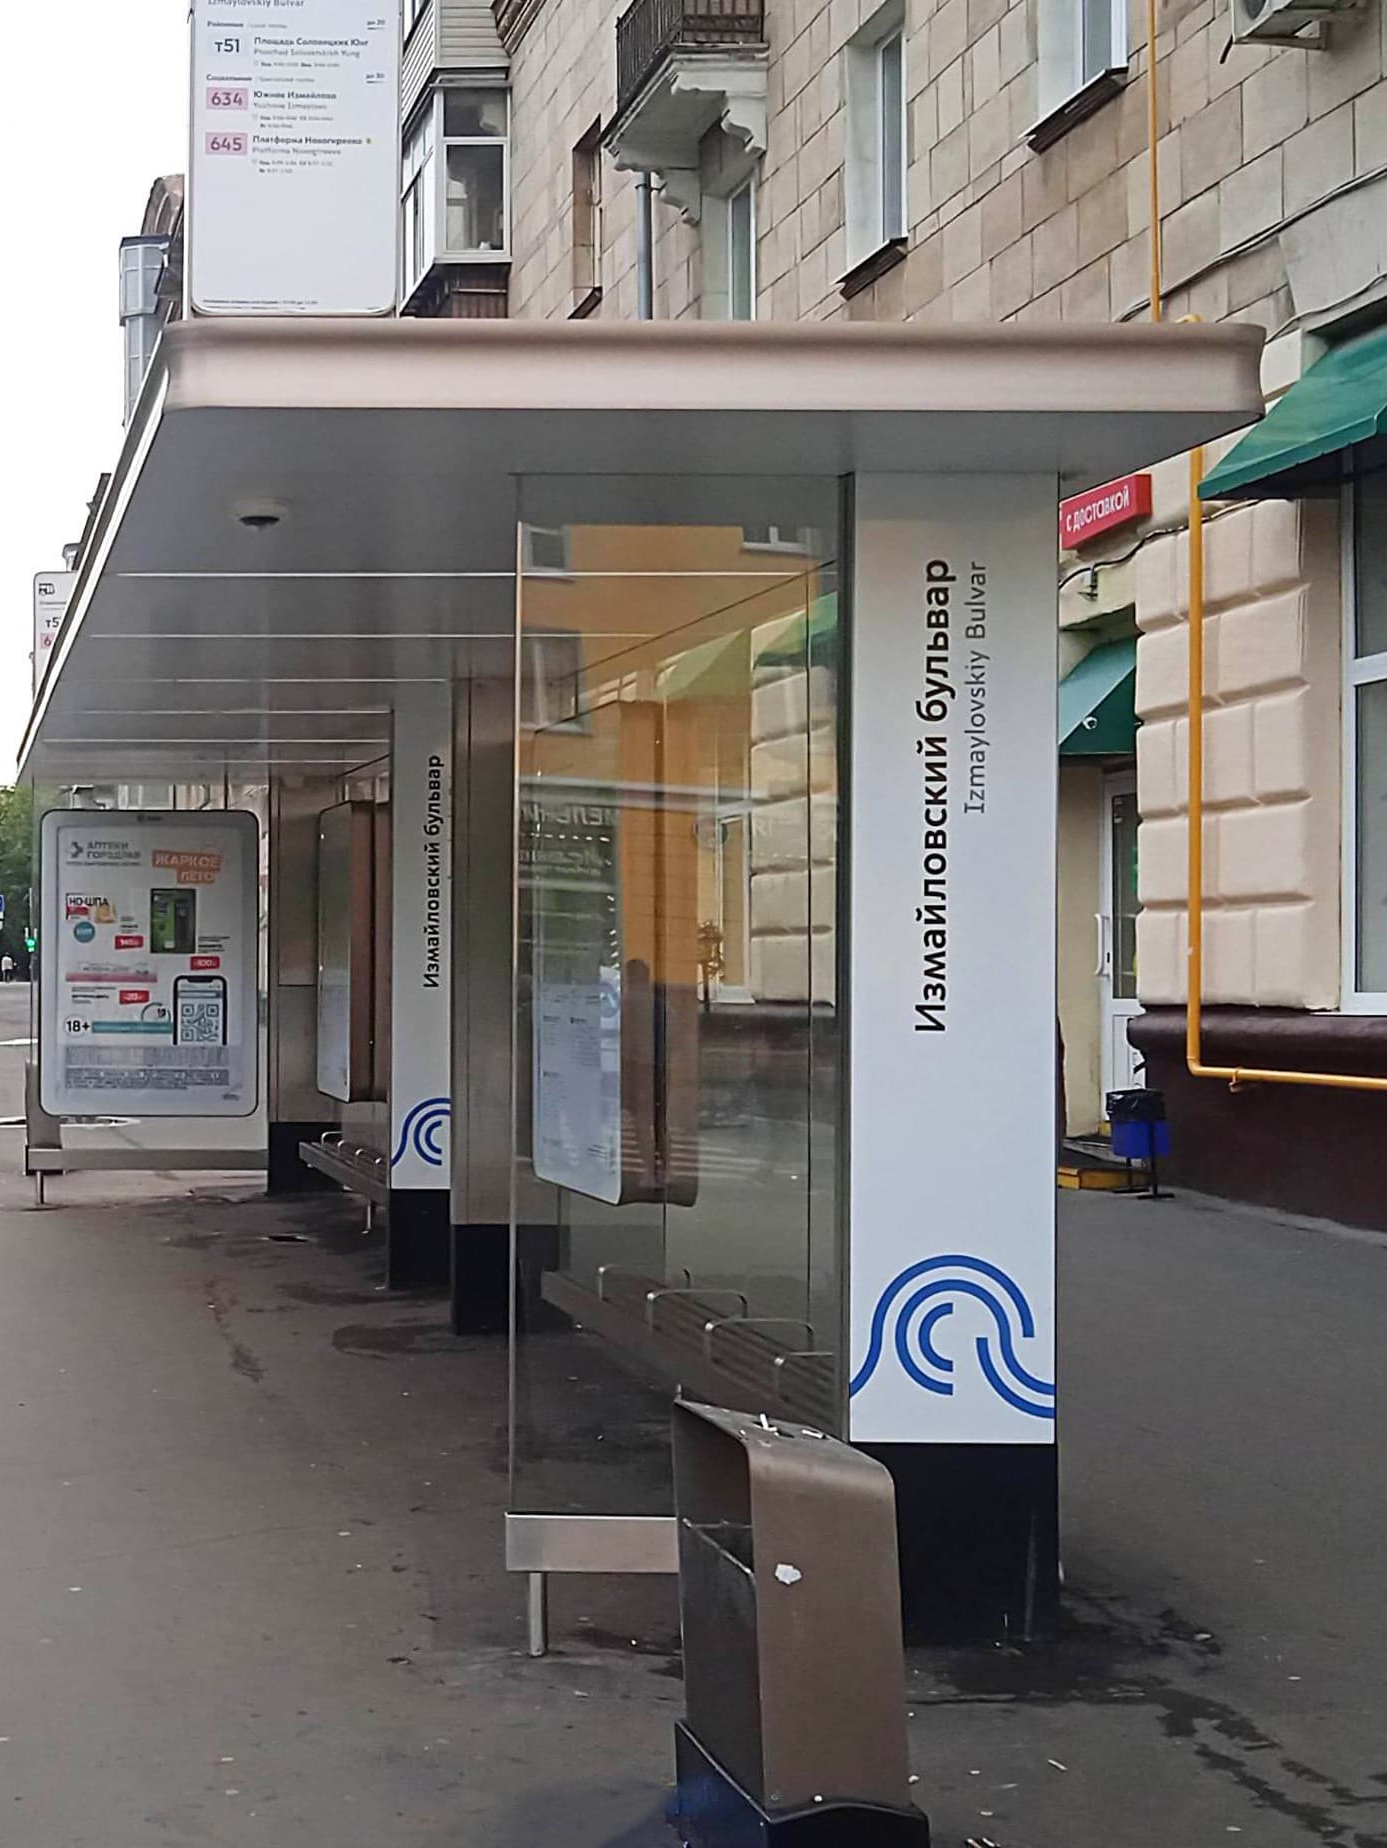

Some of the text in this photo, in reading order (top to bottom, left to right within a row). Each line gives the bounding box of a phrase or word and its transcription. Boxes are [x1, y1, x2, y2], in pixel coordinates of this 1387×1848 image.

[254, 37, 294, 46] Площадь
[211, 92, 243, 106] 634
[210, 137, 243, 151] 645
[252, 135, 303, 146] Платформа
[46, 617, 61, 628] т5
[965, 561, 990, 813] Izmaylovskiy Bulvar
[915, 558, 956, 1032] Измайловский бульвар
[155, 853, 220, 868] ЖАРКОЕ
[180, 870, 214, 881] ЛЕТО
[423, 755, 444, 987] Измайловский бульвар
[66, 1020, 90, 1032] 18+
